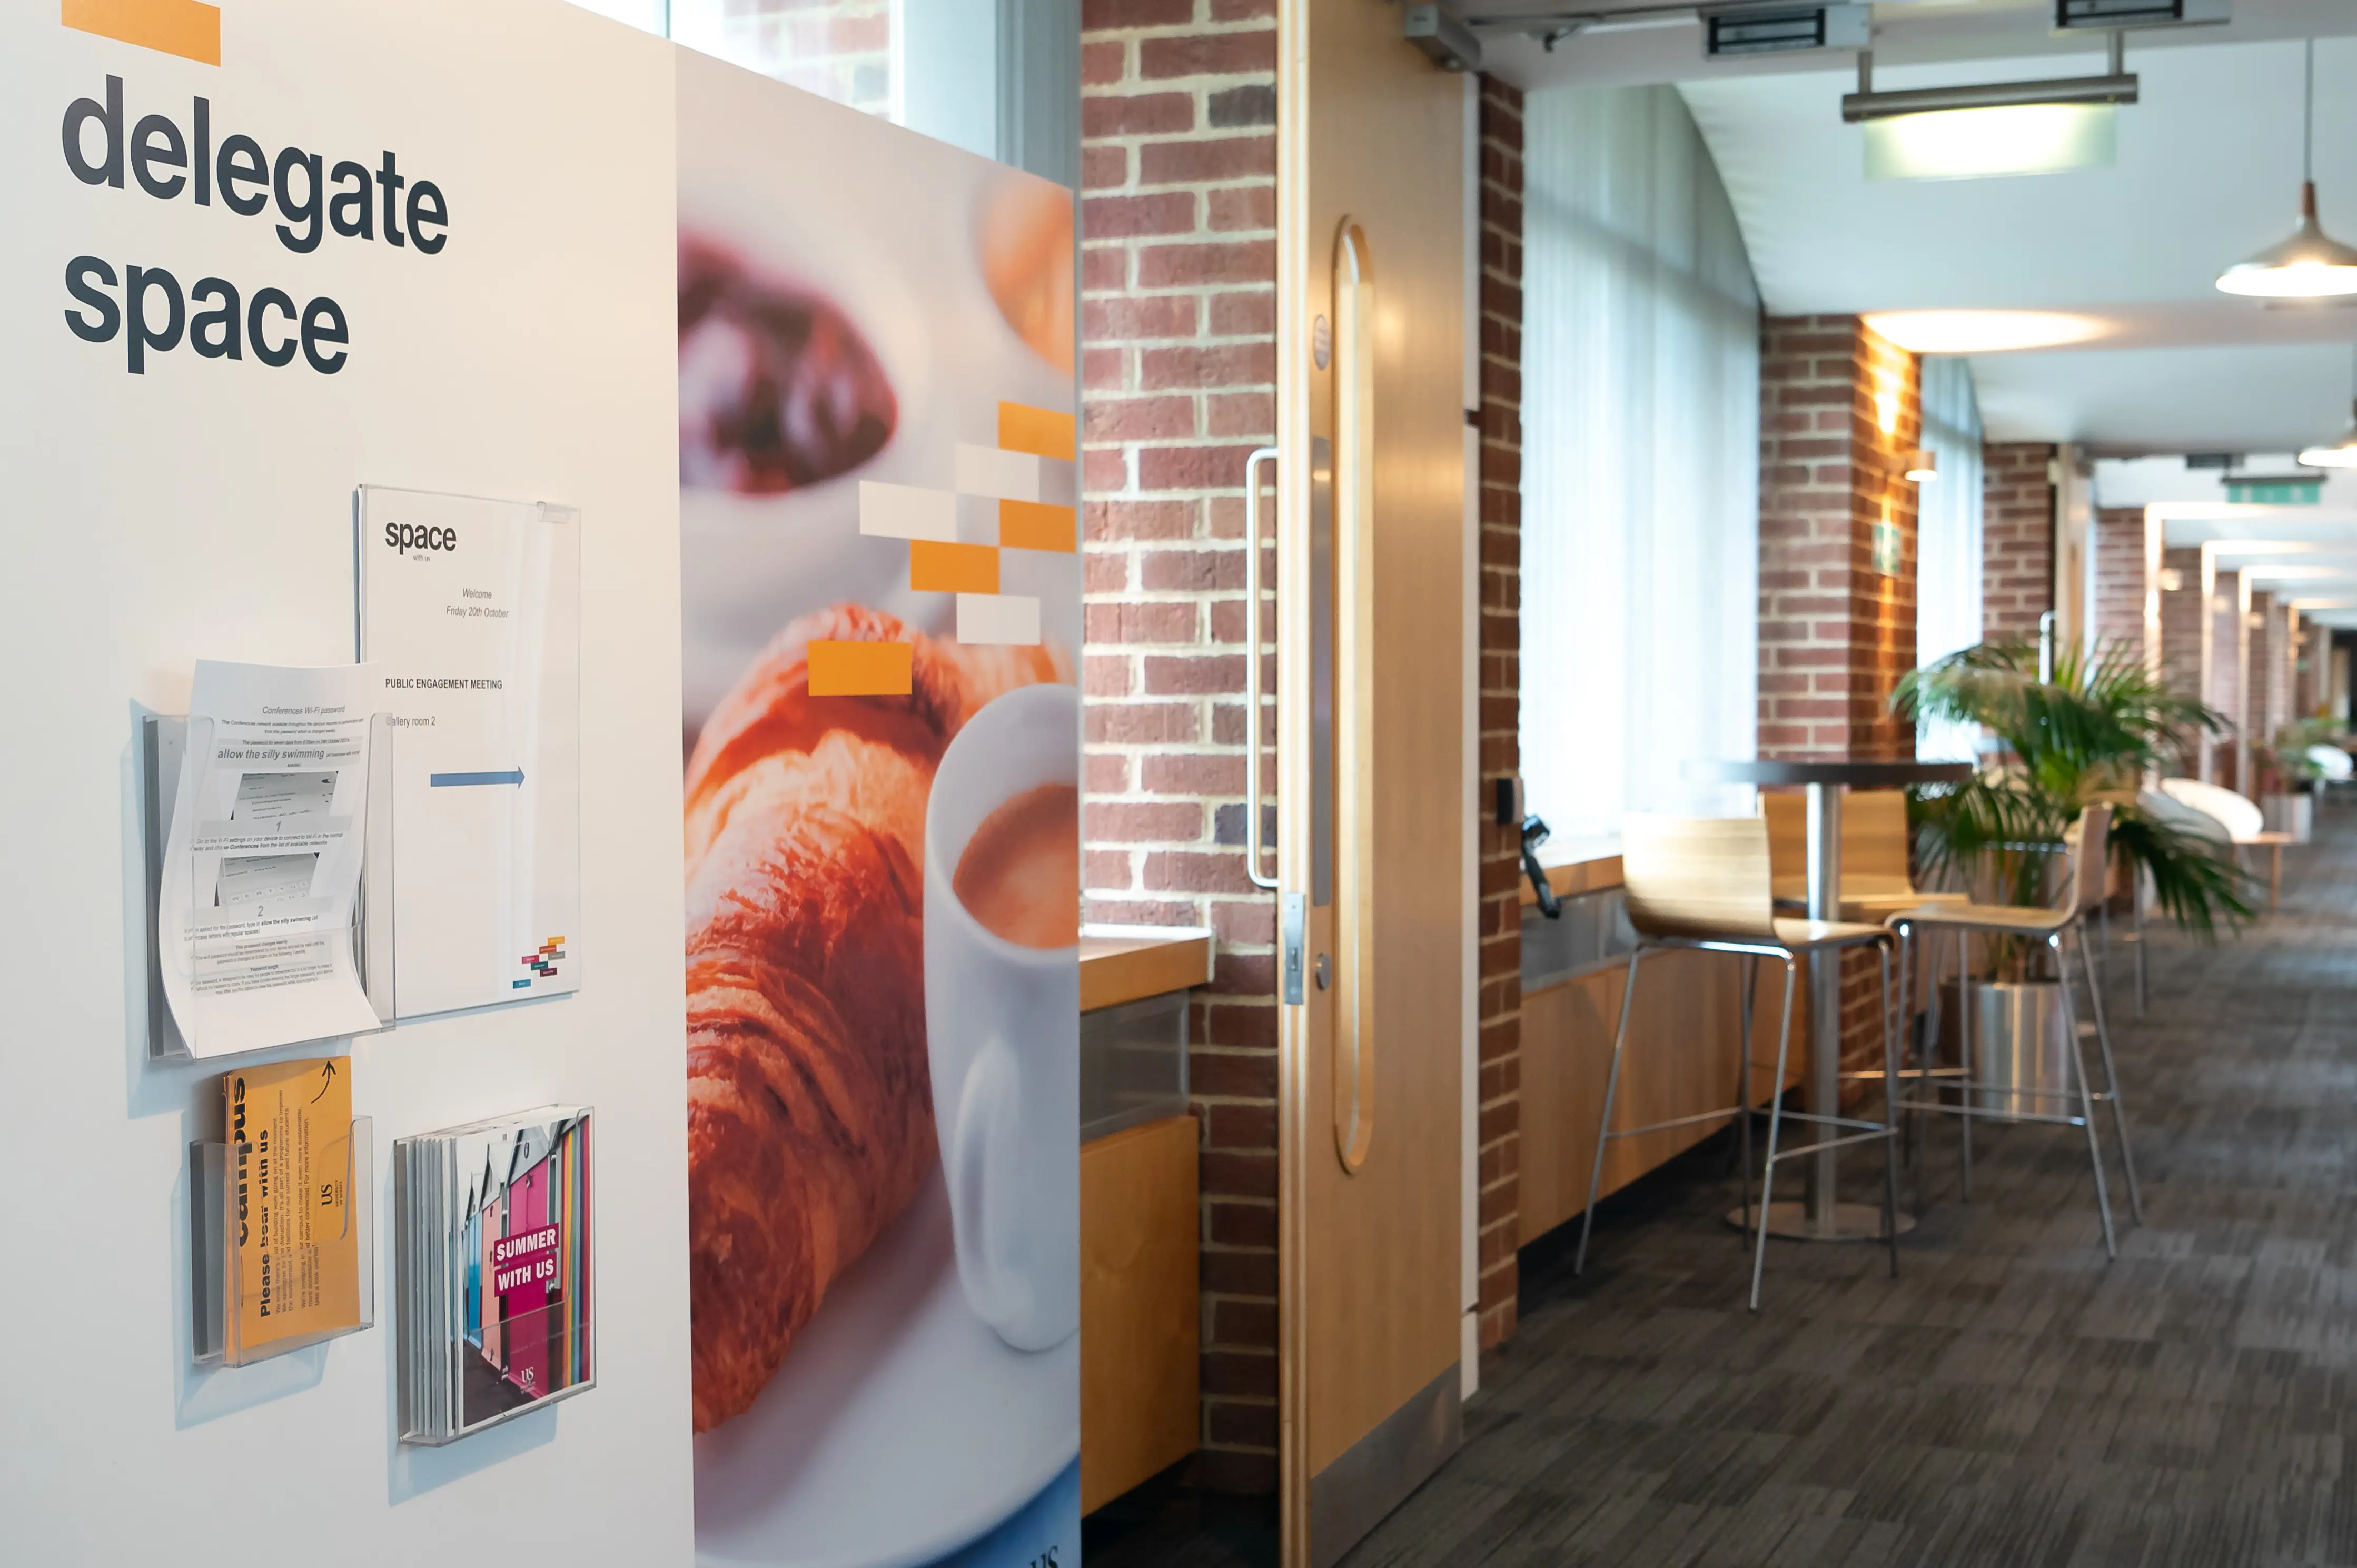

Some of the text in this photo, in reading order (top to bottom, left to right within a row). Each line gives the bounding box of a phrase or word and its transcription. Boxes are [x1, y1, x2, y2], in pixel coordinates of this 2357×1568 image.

[62, 74, 448, 255] delegate
[64, 255, 349, 375] space
[385, 522, 457, 555] space
[463, 588, 492, 599] Welcome
[446, 606, 509, 618] Friday 20th October
[385, 679, 503, 689] PUBLIC ENGAGEMENT MEETING
[262, 706, 303, 714] Conferences
[320, 706, 345, 715] password
[431, 716, 435, 726] 2
[218, 749, 244, 759] allow
[246, 749, 260, 759] the
[262, 749, 281, 761] silly
[282, 749, 325, 760] swimming
[275, 821, 281, 832] 1
[258, 906, 264, 917] 2
[260, 1130, 268, 1153] us
[259, 1159, 268, 1199] with
[497, 1227, 557, 1261] SUMMER
[498, 1259, 554, 1292] WITH US
[260, 1254, 271, 1317] Please
[521, 1366, 534, 1383] US
